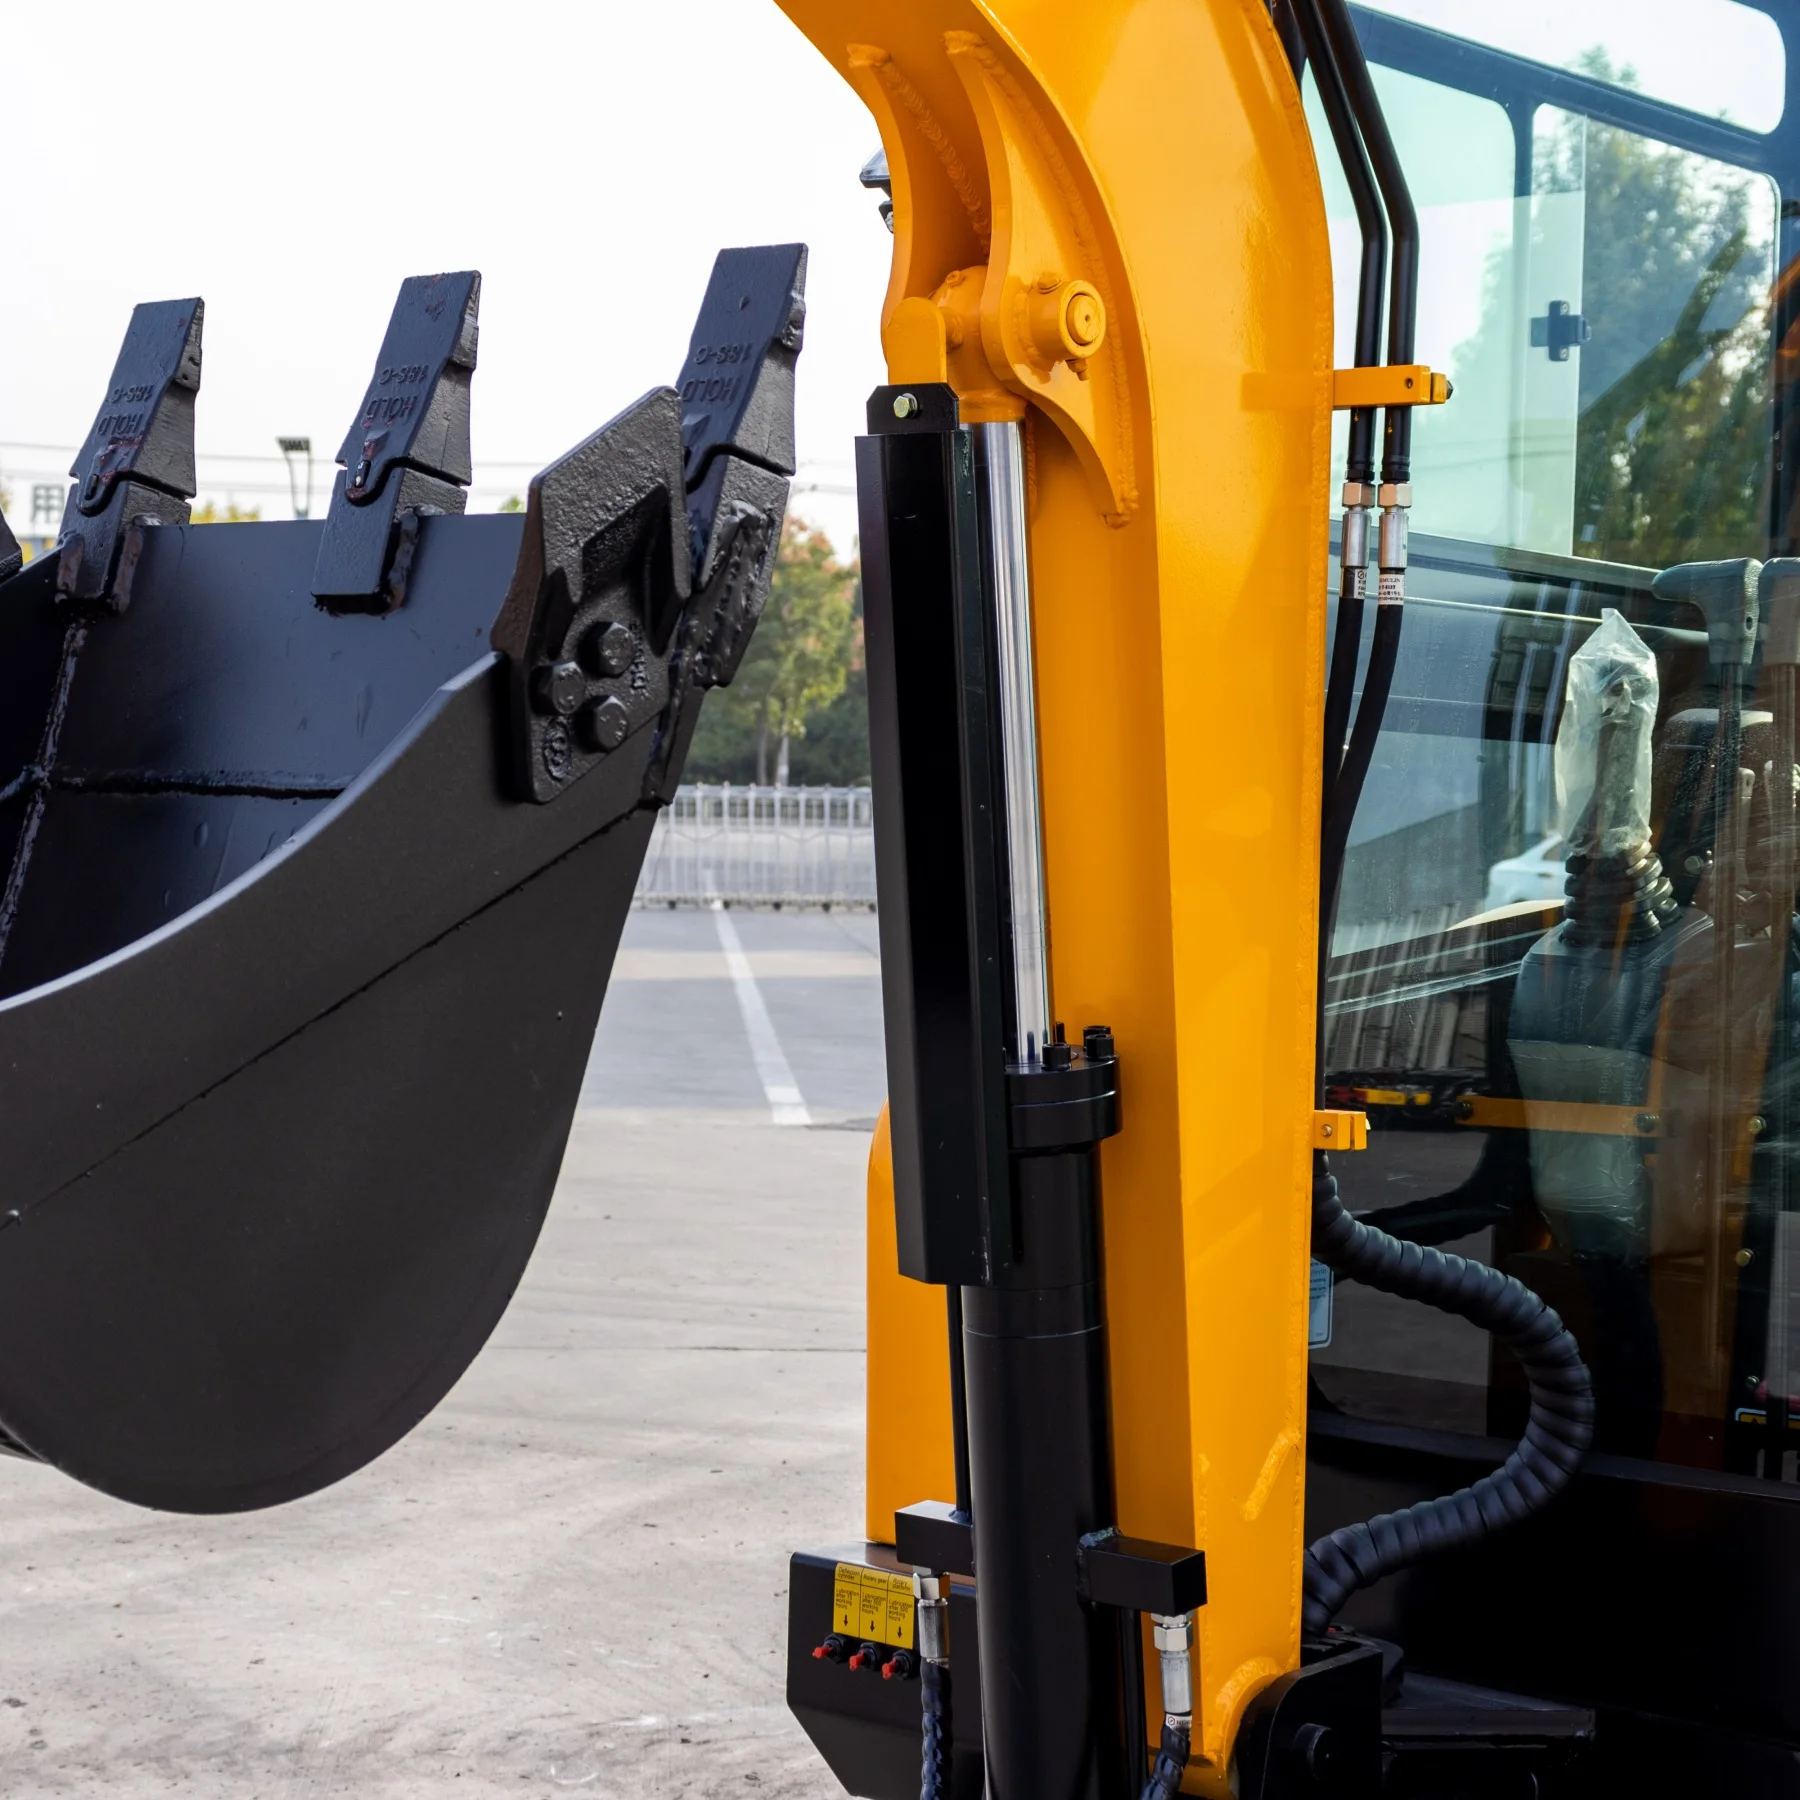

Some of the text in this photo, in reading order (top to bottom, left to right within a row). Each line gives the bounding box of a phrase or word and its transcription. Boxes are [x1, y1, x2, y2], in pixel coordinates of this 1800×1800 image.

[682, 377, 743, 403] HOLD
[365, 395, 418, 421] HOLD
[98, 413, 143, 436] HOLD
